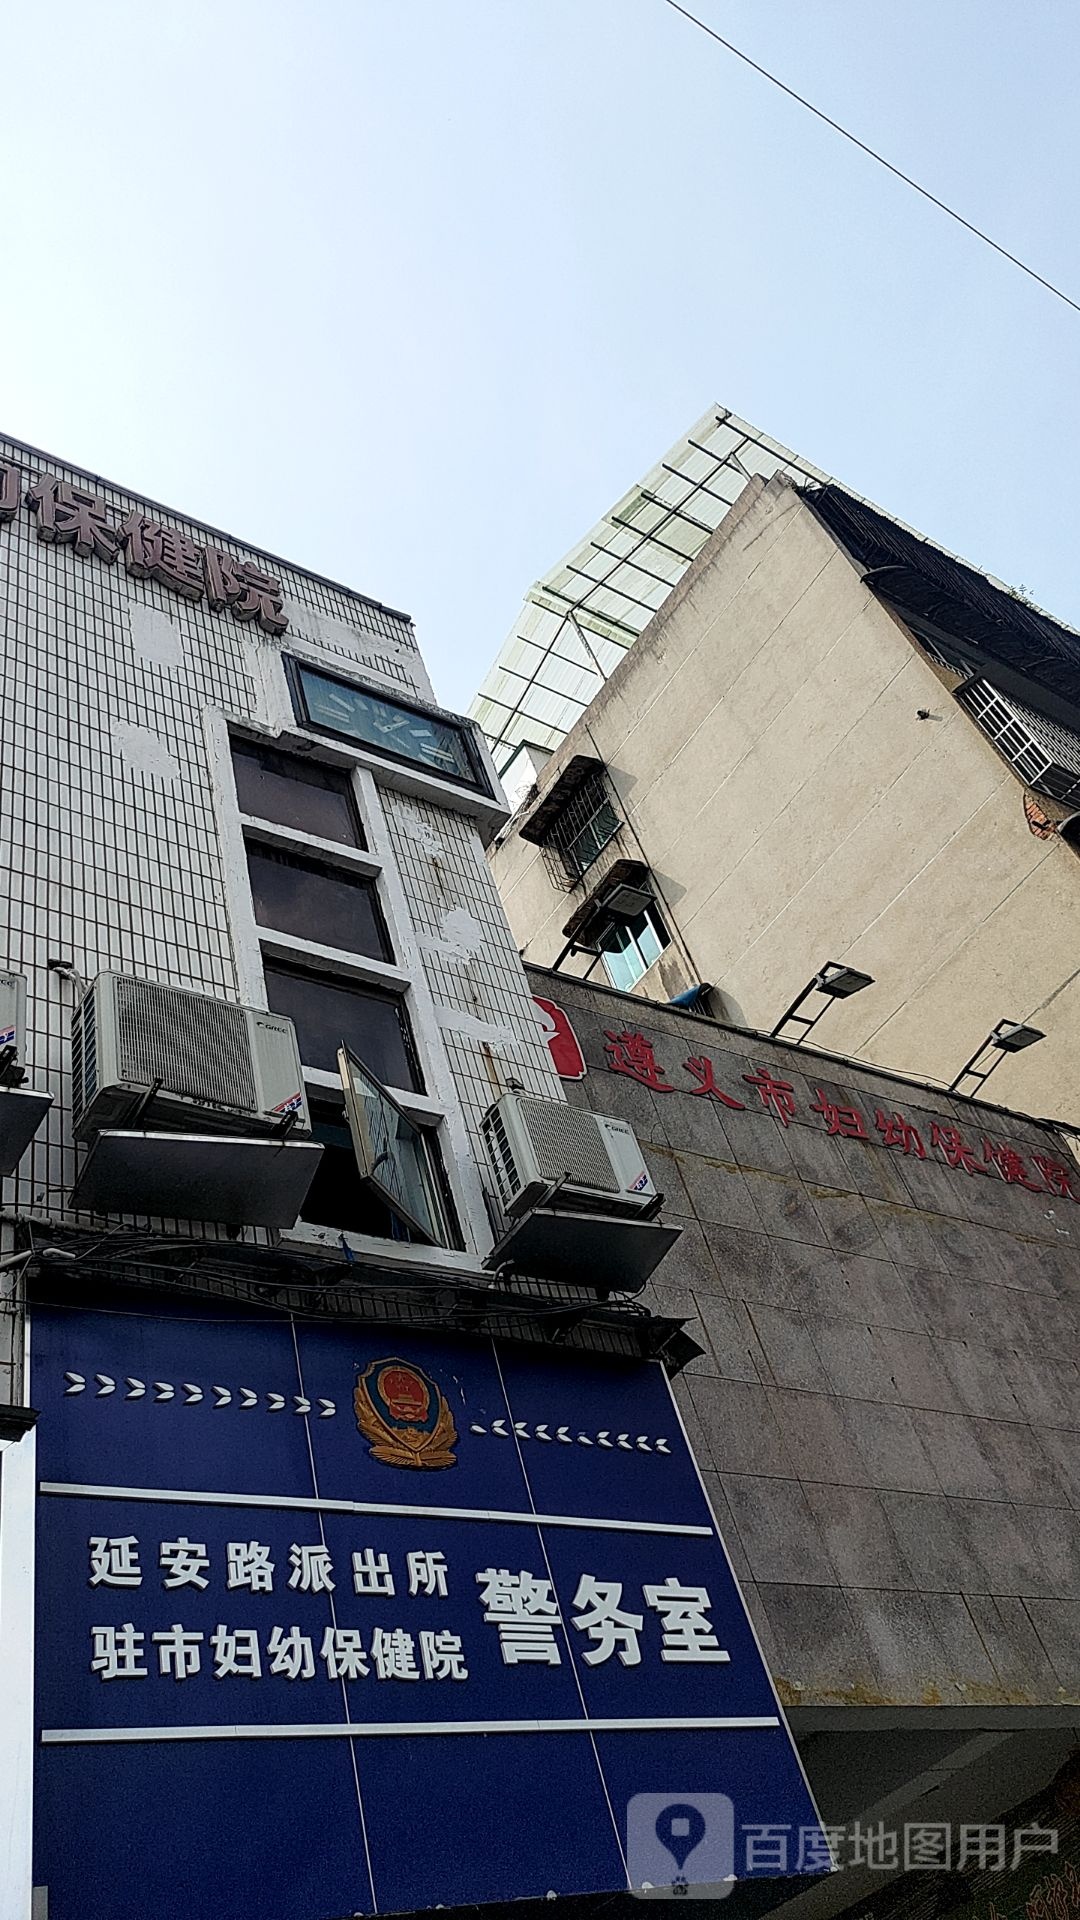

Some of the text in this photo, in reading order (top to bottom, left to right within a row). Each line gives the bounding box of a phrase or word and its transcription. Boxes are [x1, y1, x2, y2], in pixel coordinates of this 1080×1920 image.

[604, 1030, 1080, 1204] 遵义市妇幼保健院
[89, 1536, 450, 1598] 延安路派出所
[90, 1624, 470, 1682] 驻市妇幼保健院
[476, 1567, 732, 1667] 警务室
